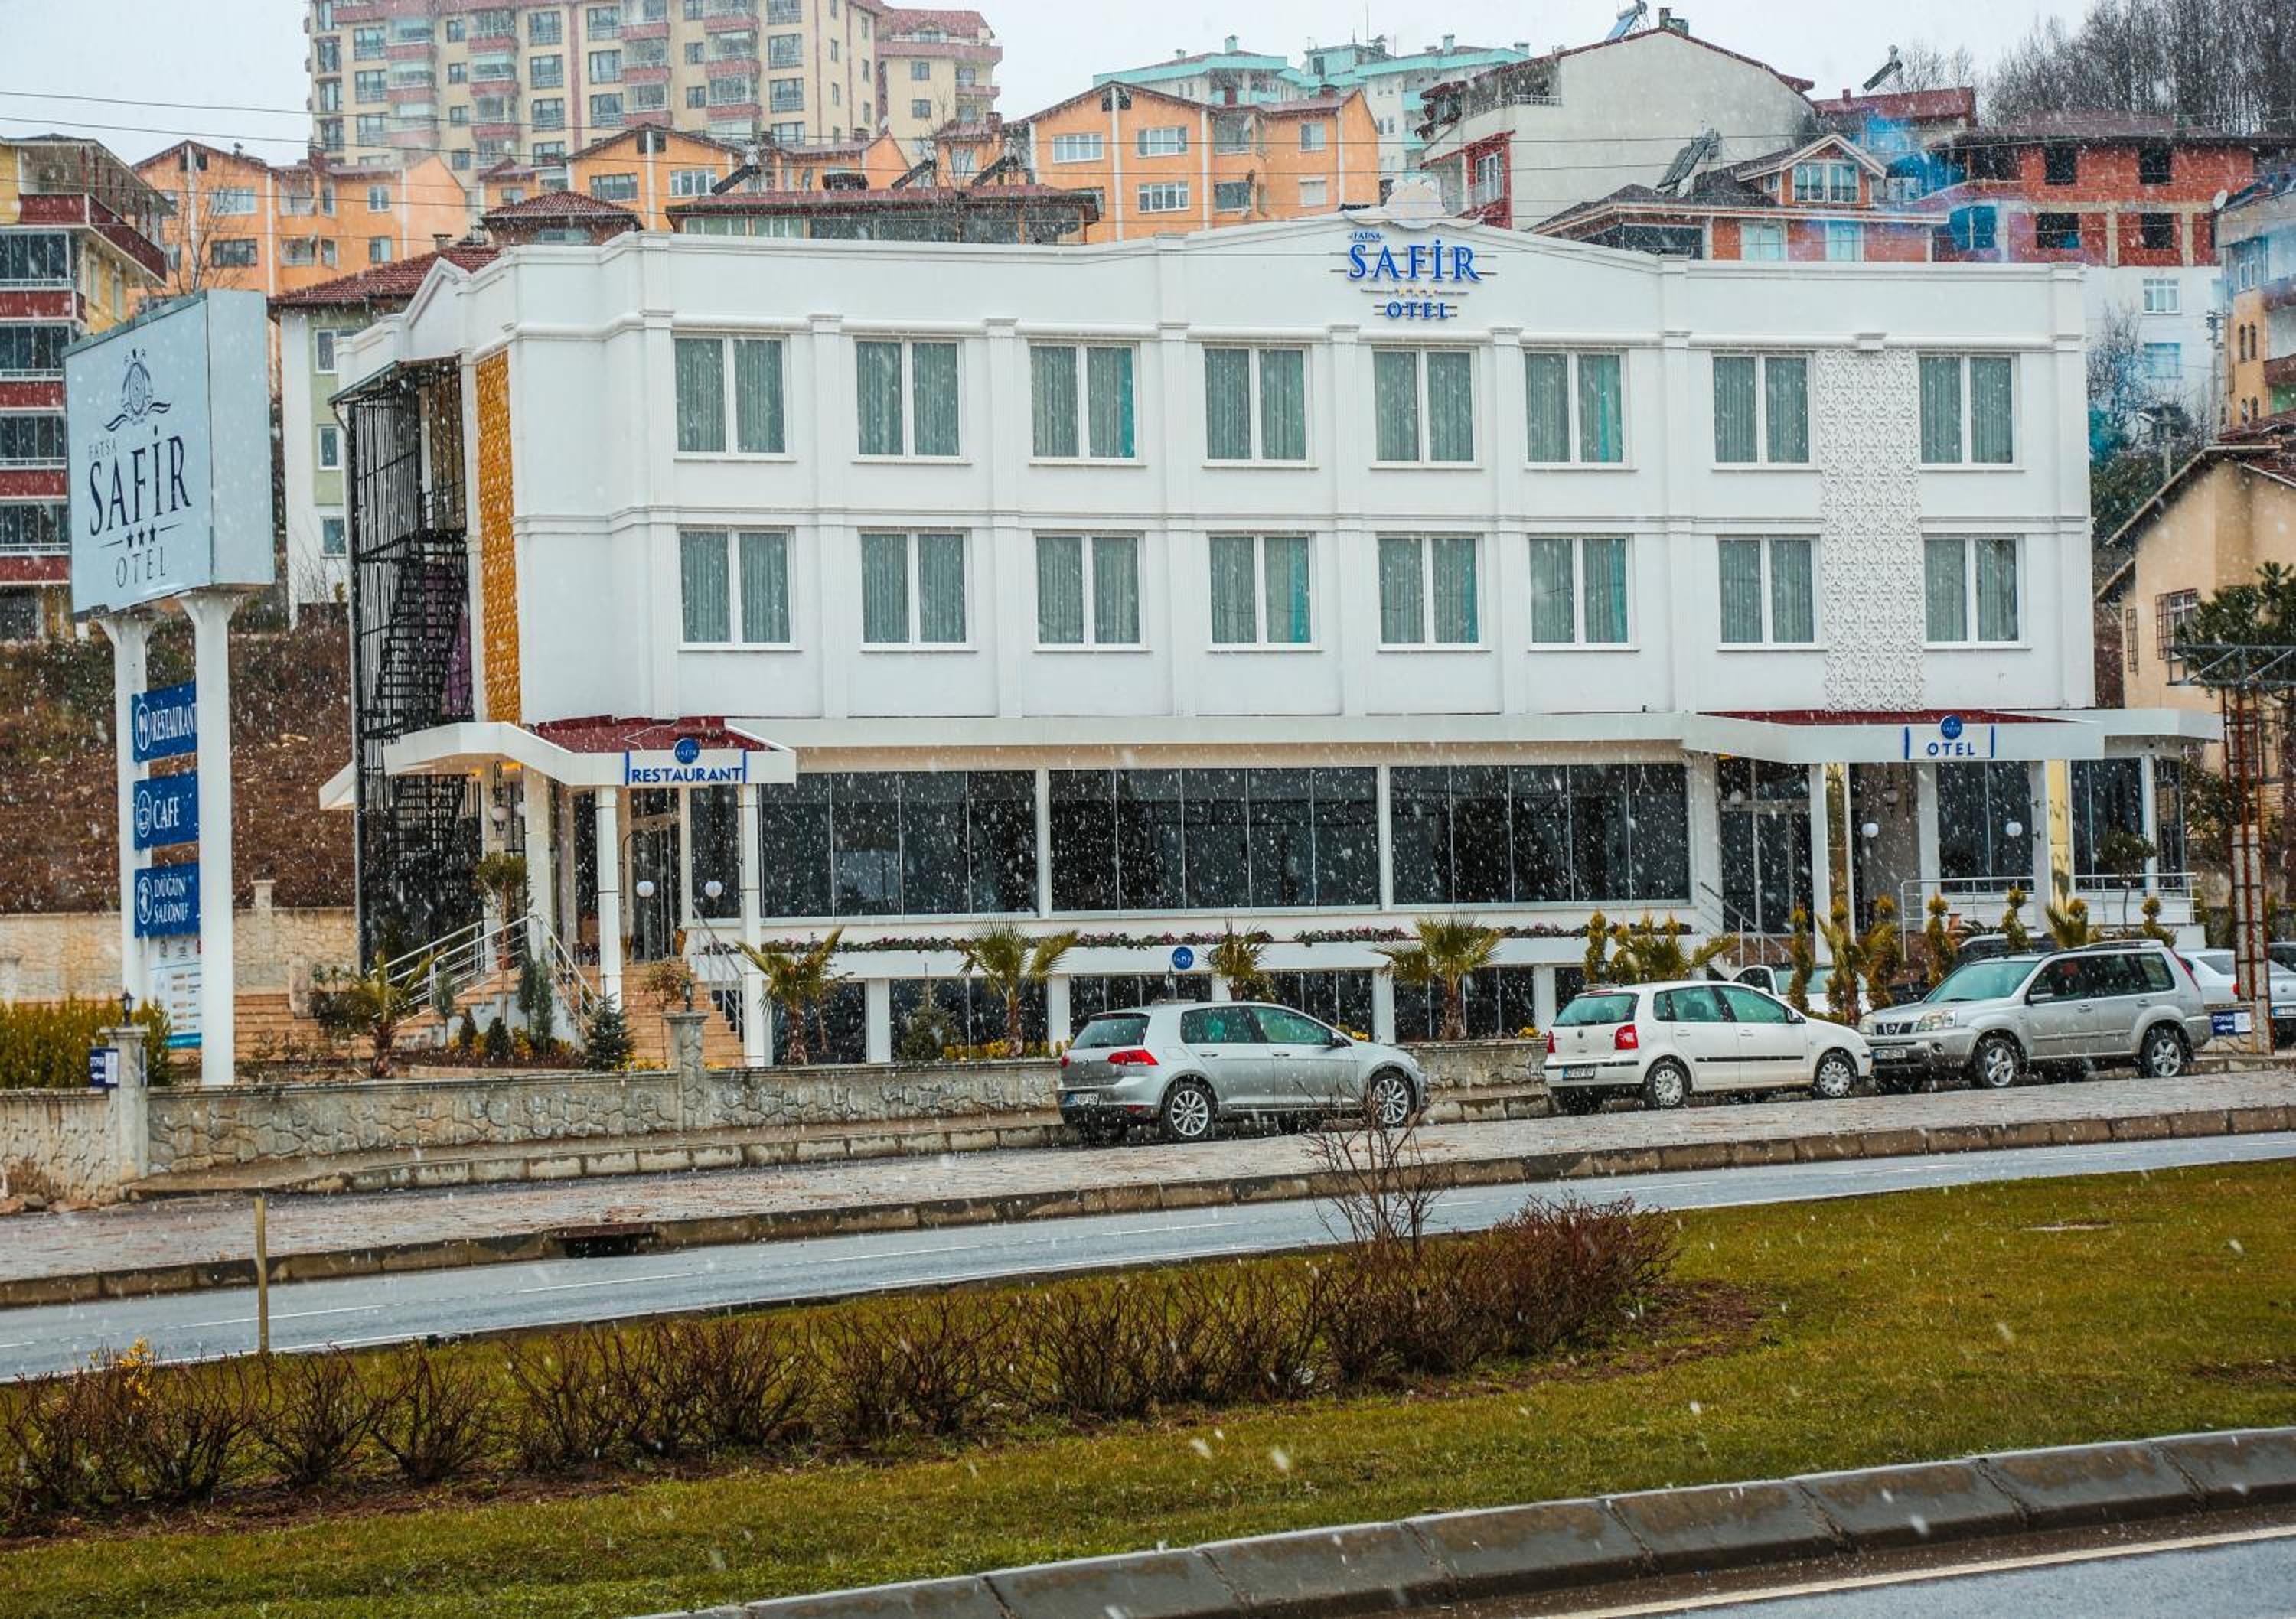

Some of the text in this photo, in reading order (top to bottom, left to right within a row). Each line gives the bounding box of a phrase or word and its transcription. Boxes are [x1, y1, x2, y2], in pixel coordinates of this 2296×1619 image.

[1349, 239, 1482, 281] SAFİR
[1386, 301, 1448, 319] OTEL
[90, 425, 192, 536] SAFİR
[116, 546, 166, 588] OTEL
[1927, 742, 1975, 756] OTEL
[631, 767, 742, 782] RESTAURANT
[153, 797, 180, 829] CAFE
